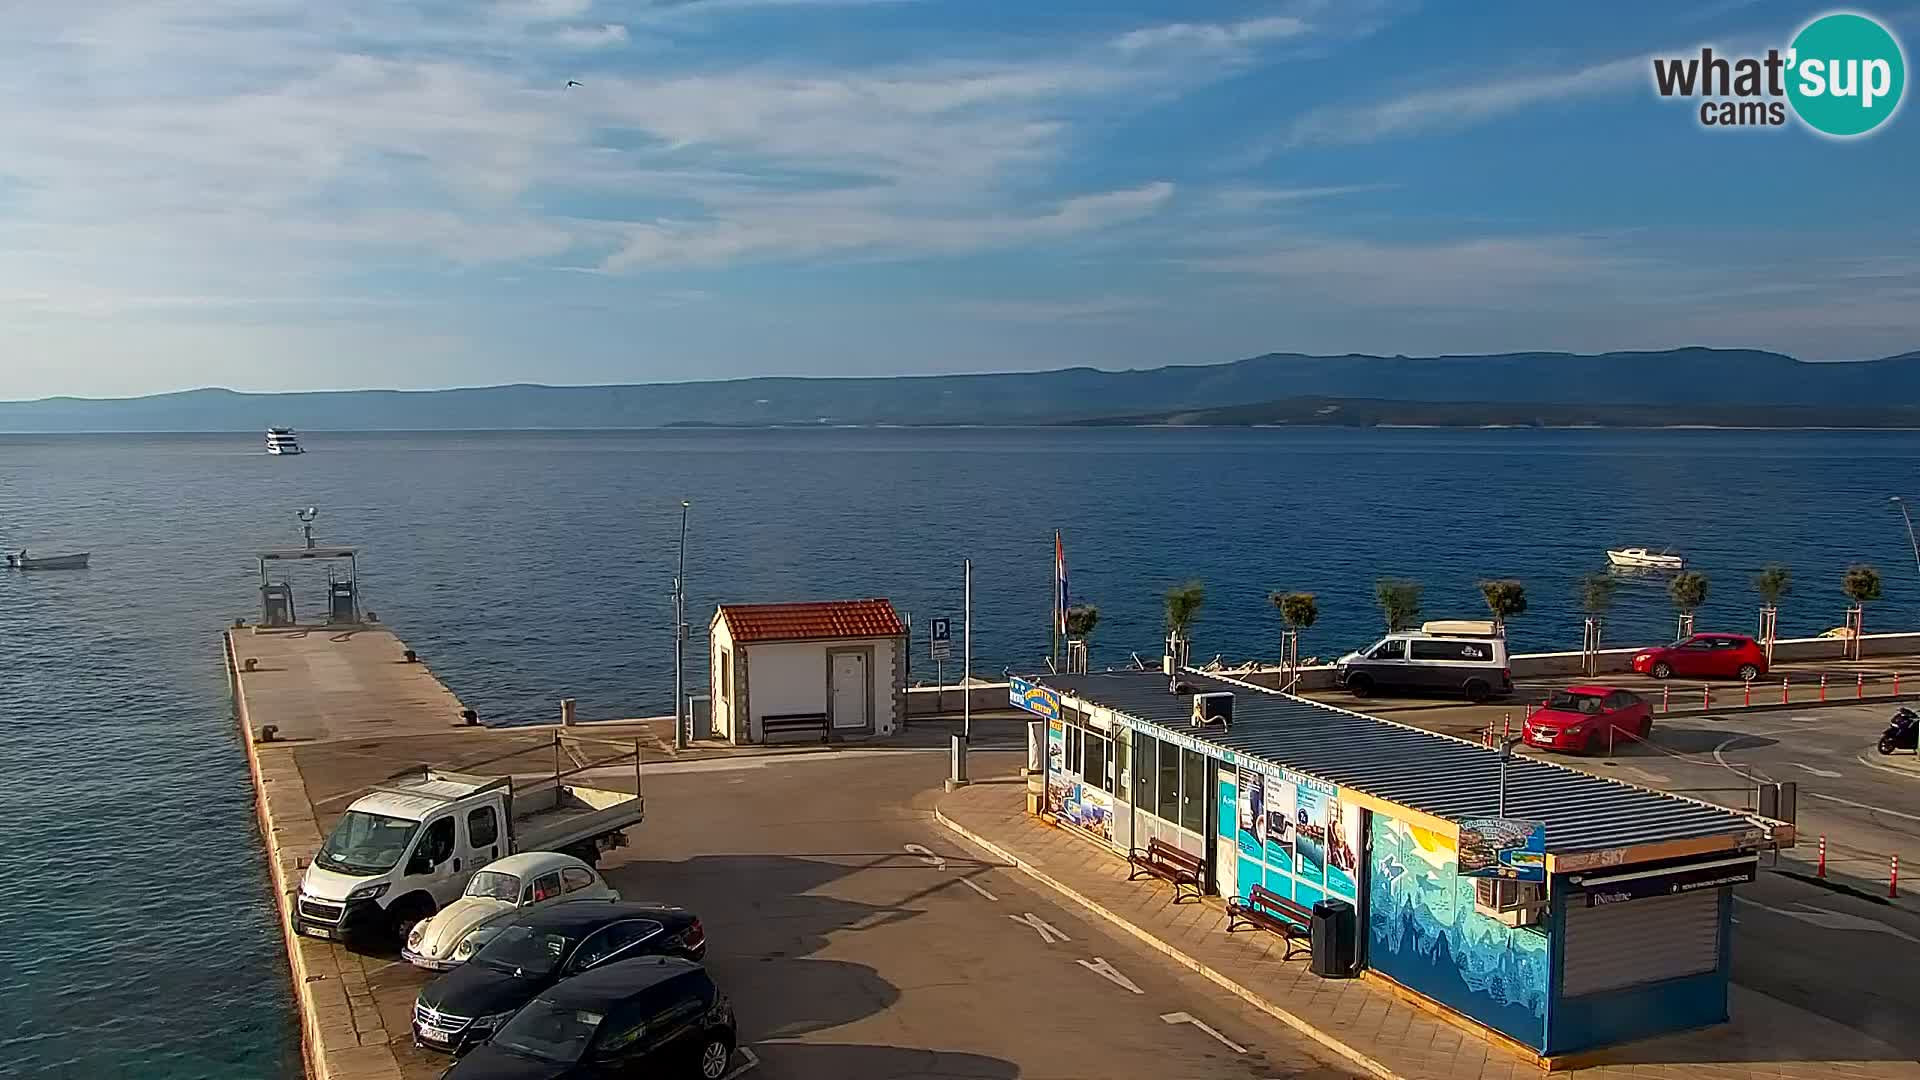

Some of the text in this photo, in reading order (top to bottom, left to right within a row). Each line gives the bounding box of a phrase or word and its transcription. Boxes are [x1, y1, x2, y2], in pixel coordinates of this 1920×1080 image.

[936, 621, 946, 638] P
[1195, 741, 1225, 760] POSTAJA
[1234, 754, 1248, 768] BUS
[1248, 758, 1280, 778] STATION
[1281, 768, 1306, 786] TICKET
[1307, 779, 1334, 796] OFFICE
